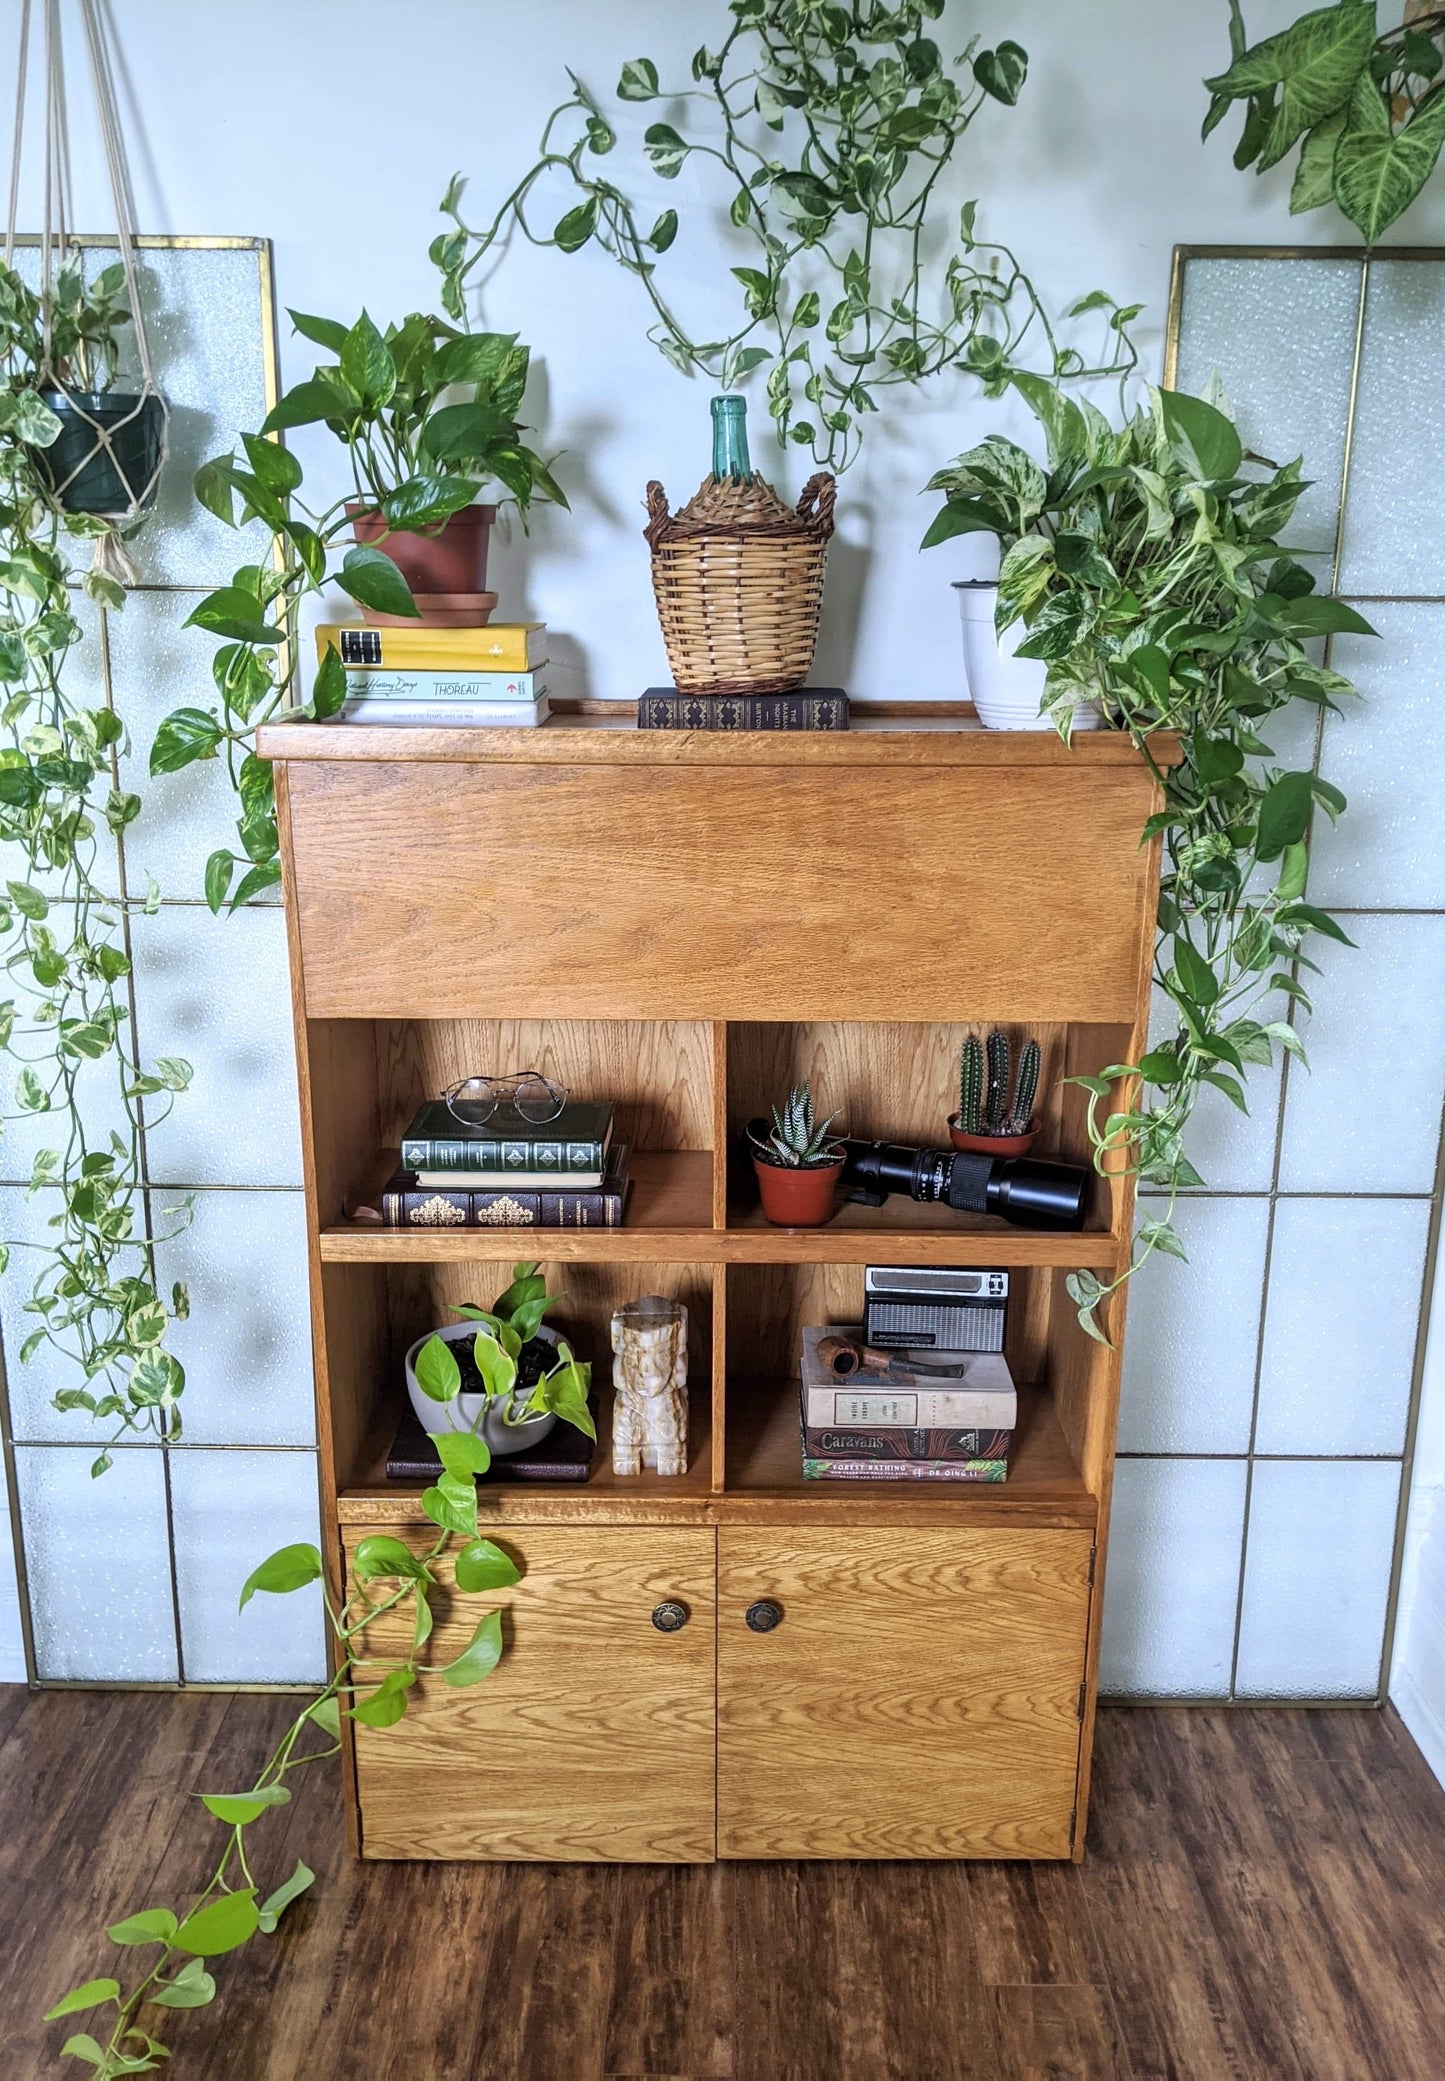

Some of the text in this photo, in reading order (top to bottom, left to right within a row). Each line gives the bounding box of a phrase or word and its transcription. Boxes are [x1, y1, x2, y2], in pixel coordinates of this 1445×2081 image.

[433, 682, 481, 696] THOREAU
[861, 1401, 869, 1420] EUROPE
[821, 1432, 884, 1450] Caravans
[868, 1464, 906, 1472] BATHING
